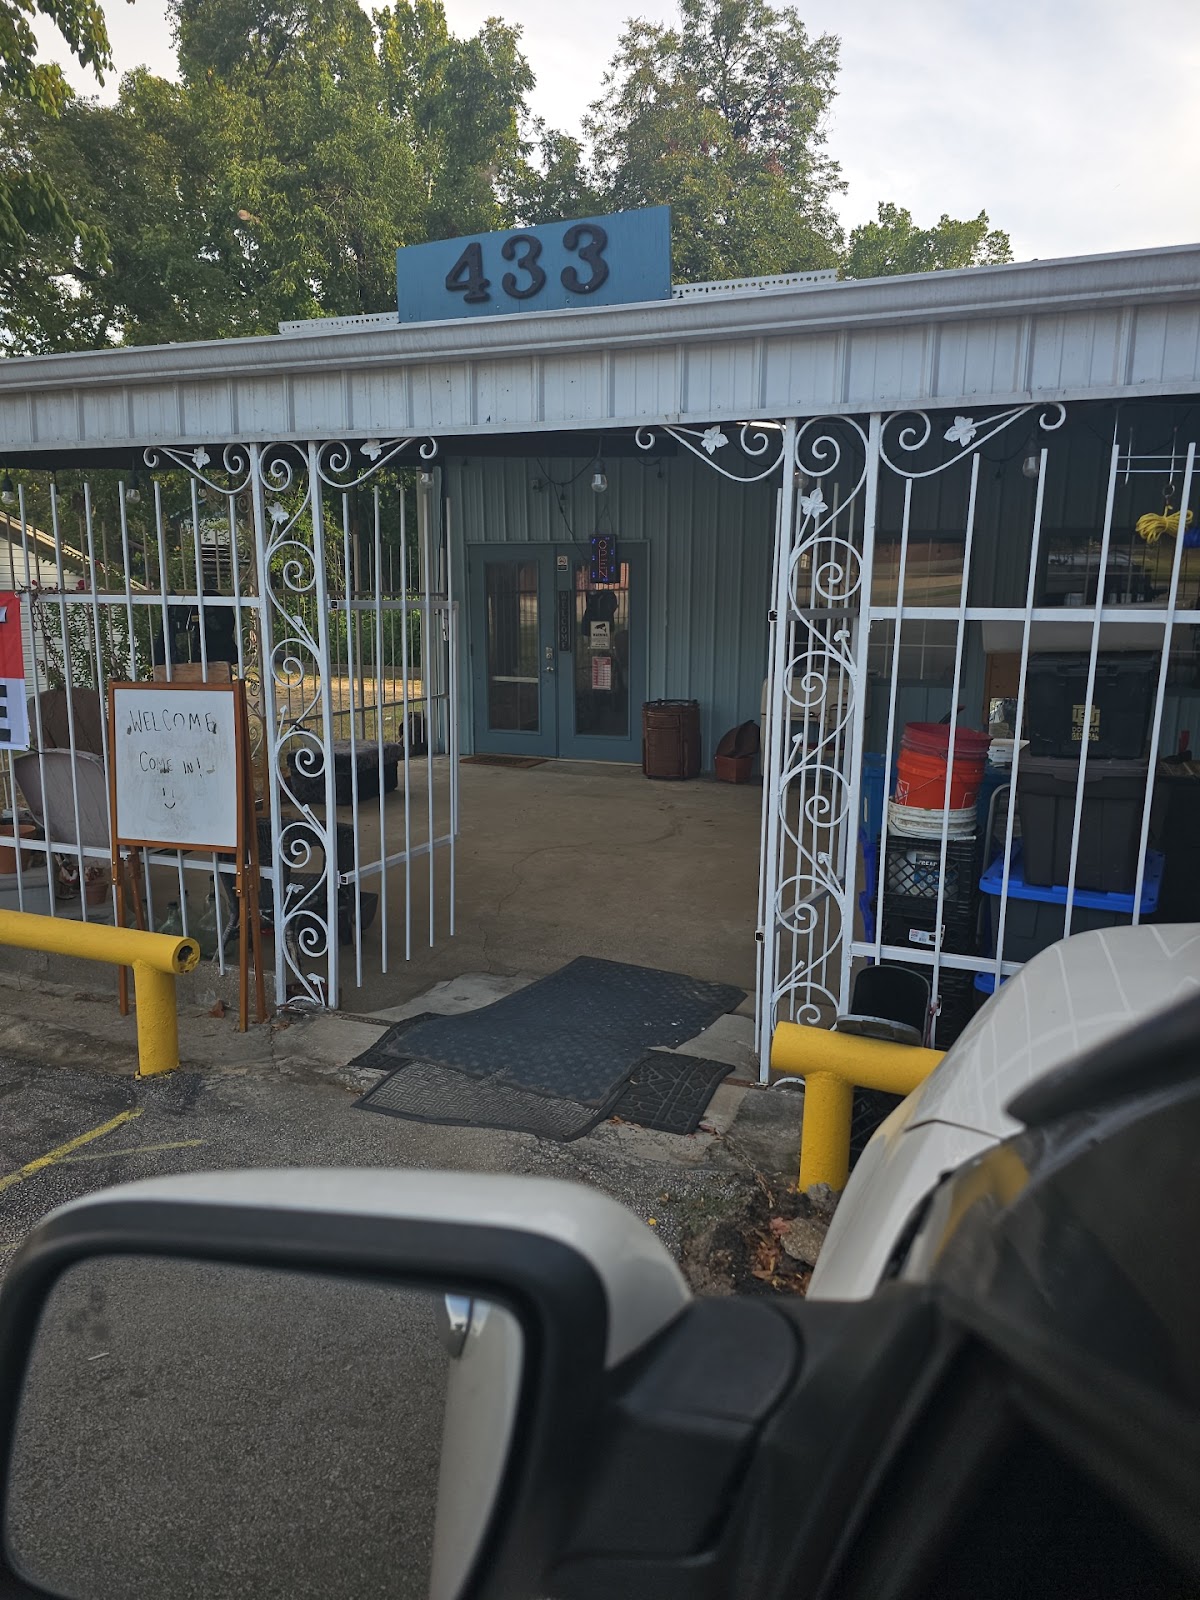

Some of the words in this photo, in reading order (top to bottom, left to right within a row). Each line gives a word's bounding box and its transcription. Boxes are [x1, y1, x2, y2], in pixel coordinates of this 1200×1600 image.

[445, 224, 610, 304] 433
[598, 540, 608, 578] OPEN
[560, 591, 568, 649] WELCOME
[129, 708, 217, 734] WELCOME
